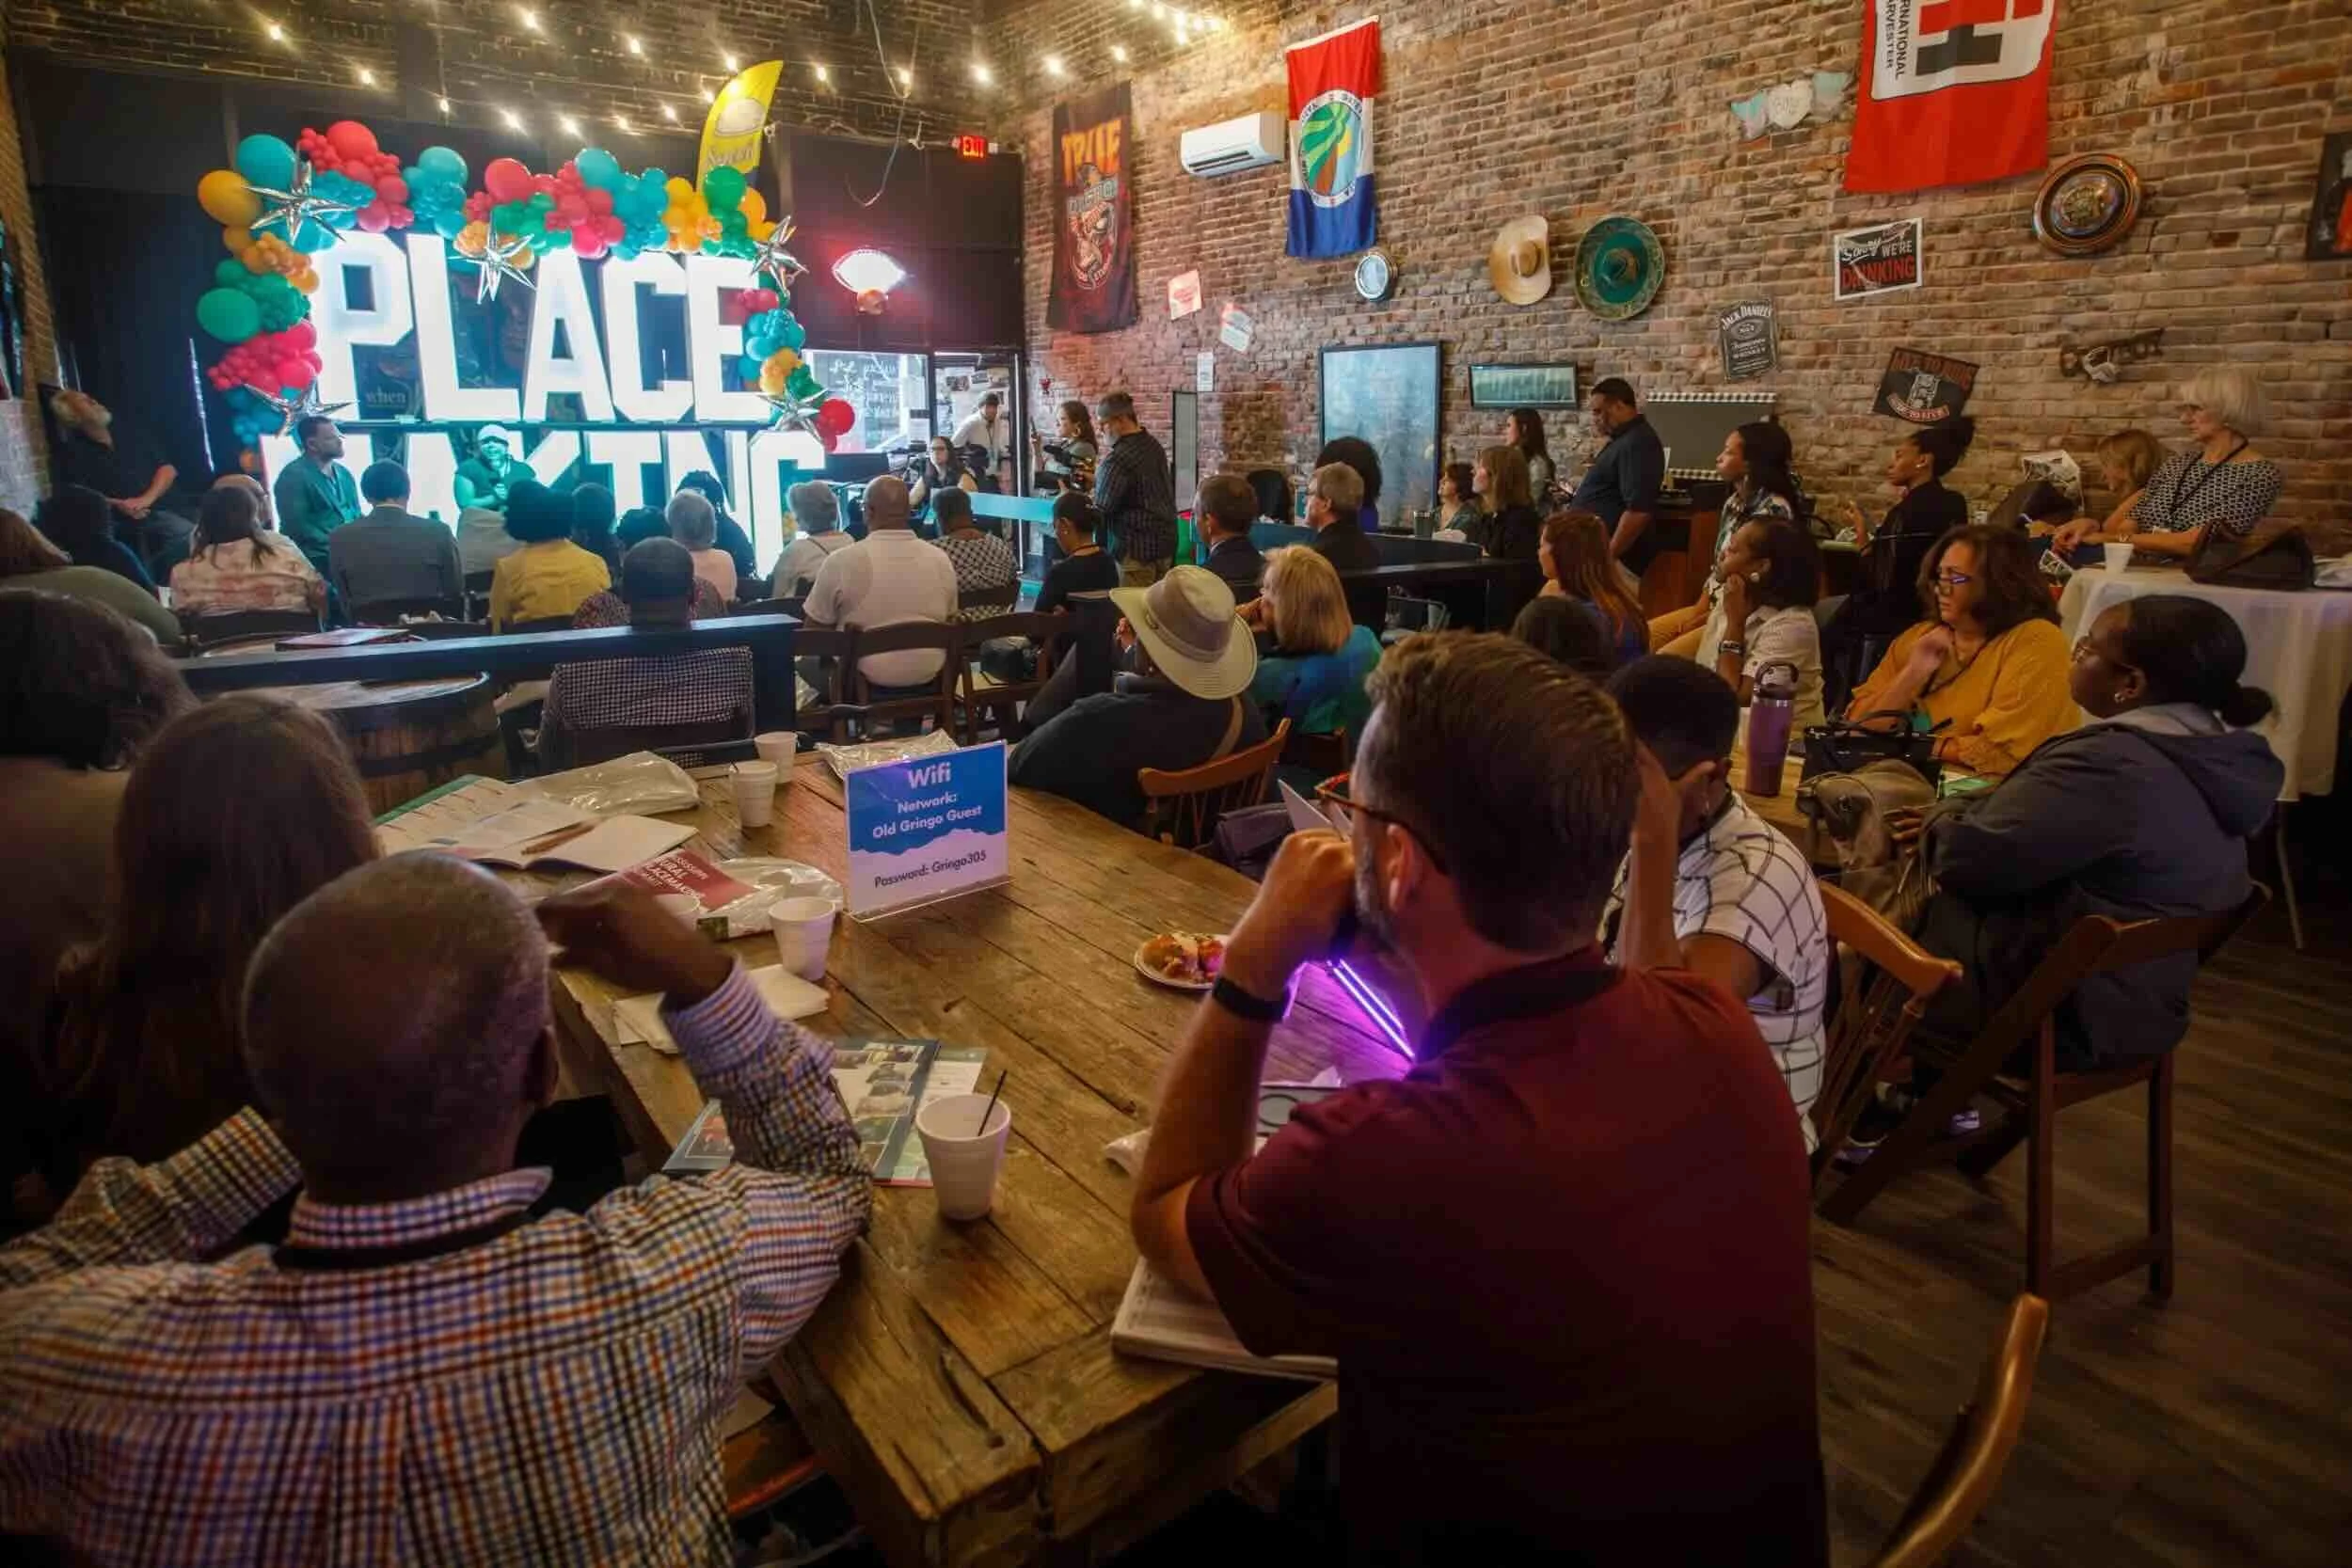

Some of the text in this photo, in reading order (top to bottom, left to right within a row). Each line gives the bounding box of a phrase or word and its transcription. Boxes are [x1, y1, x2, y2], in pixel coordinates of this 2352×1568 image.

[962, 135, 985, 158] EXIT
[313, 230, 770, 422] PLACE
[907, 762, 952, 789] Wifi
[898, 791, 958, 814] Network:
[872, 805, 983, 838] Old Gringo Guest
[874, 849, 987, 889] Password: Gringo305
